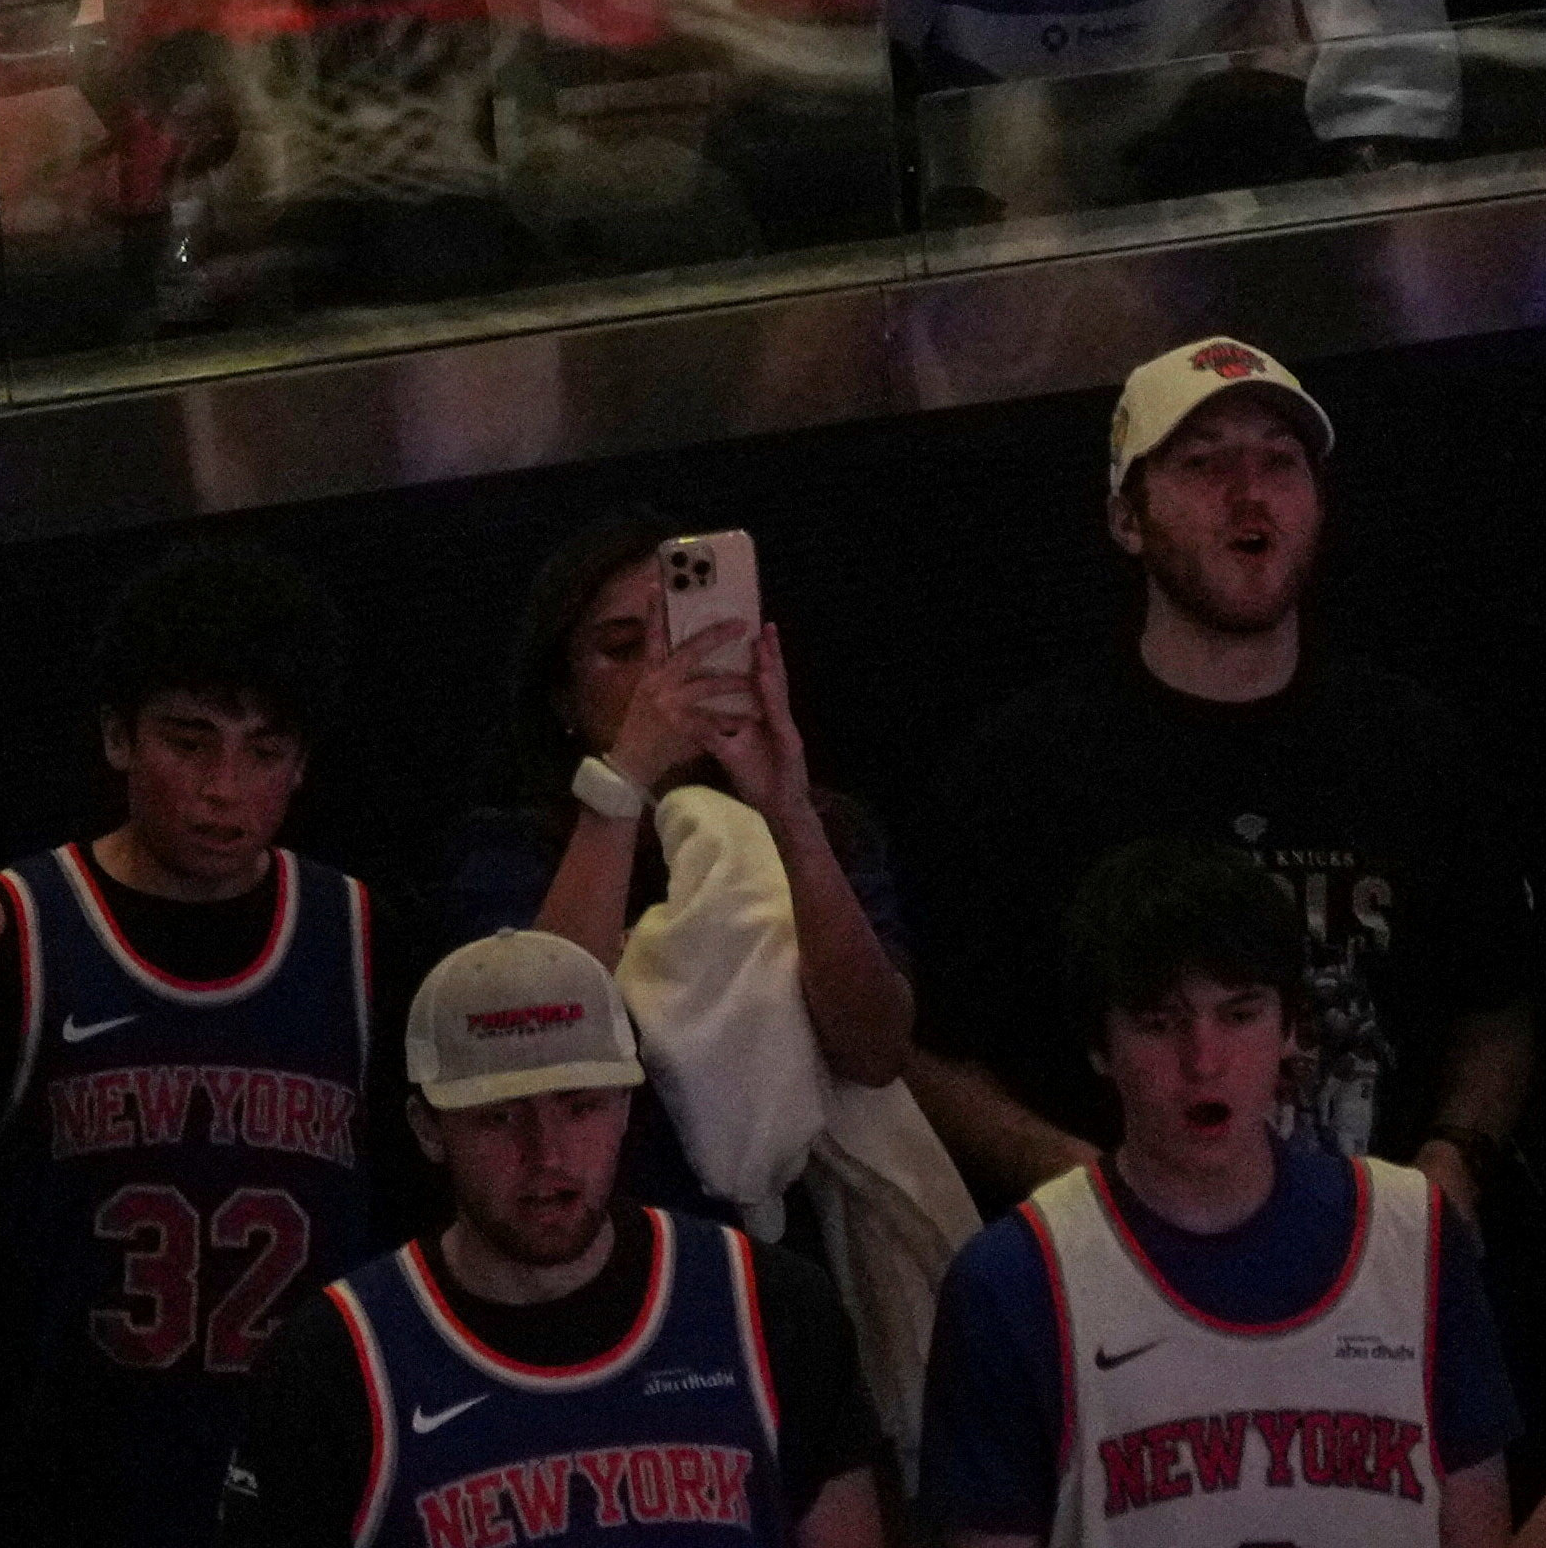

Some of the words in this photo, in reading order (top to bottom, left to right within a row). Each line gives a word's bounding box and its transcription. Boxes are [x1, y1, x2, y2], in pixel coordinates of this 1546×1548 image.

[49, 1065, 198, 1161] NEW
[199, 1064, 356, 1171] YORK
[88, 1182, 312, 1374] 32
[415, 1453, 574, 1548] NEW
[573, 1441, 754, 1534] YORK
[1099, 1410, 1250, 1520] NEW
[1252, 1407, 1425, 1504] YORK
